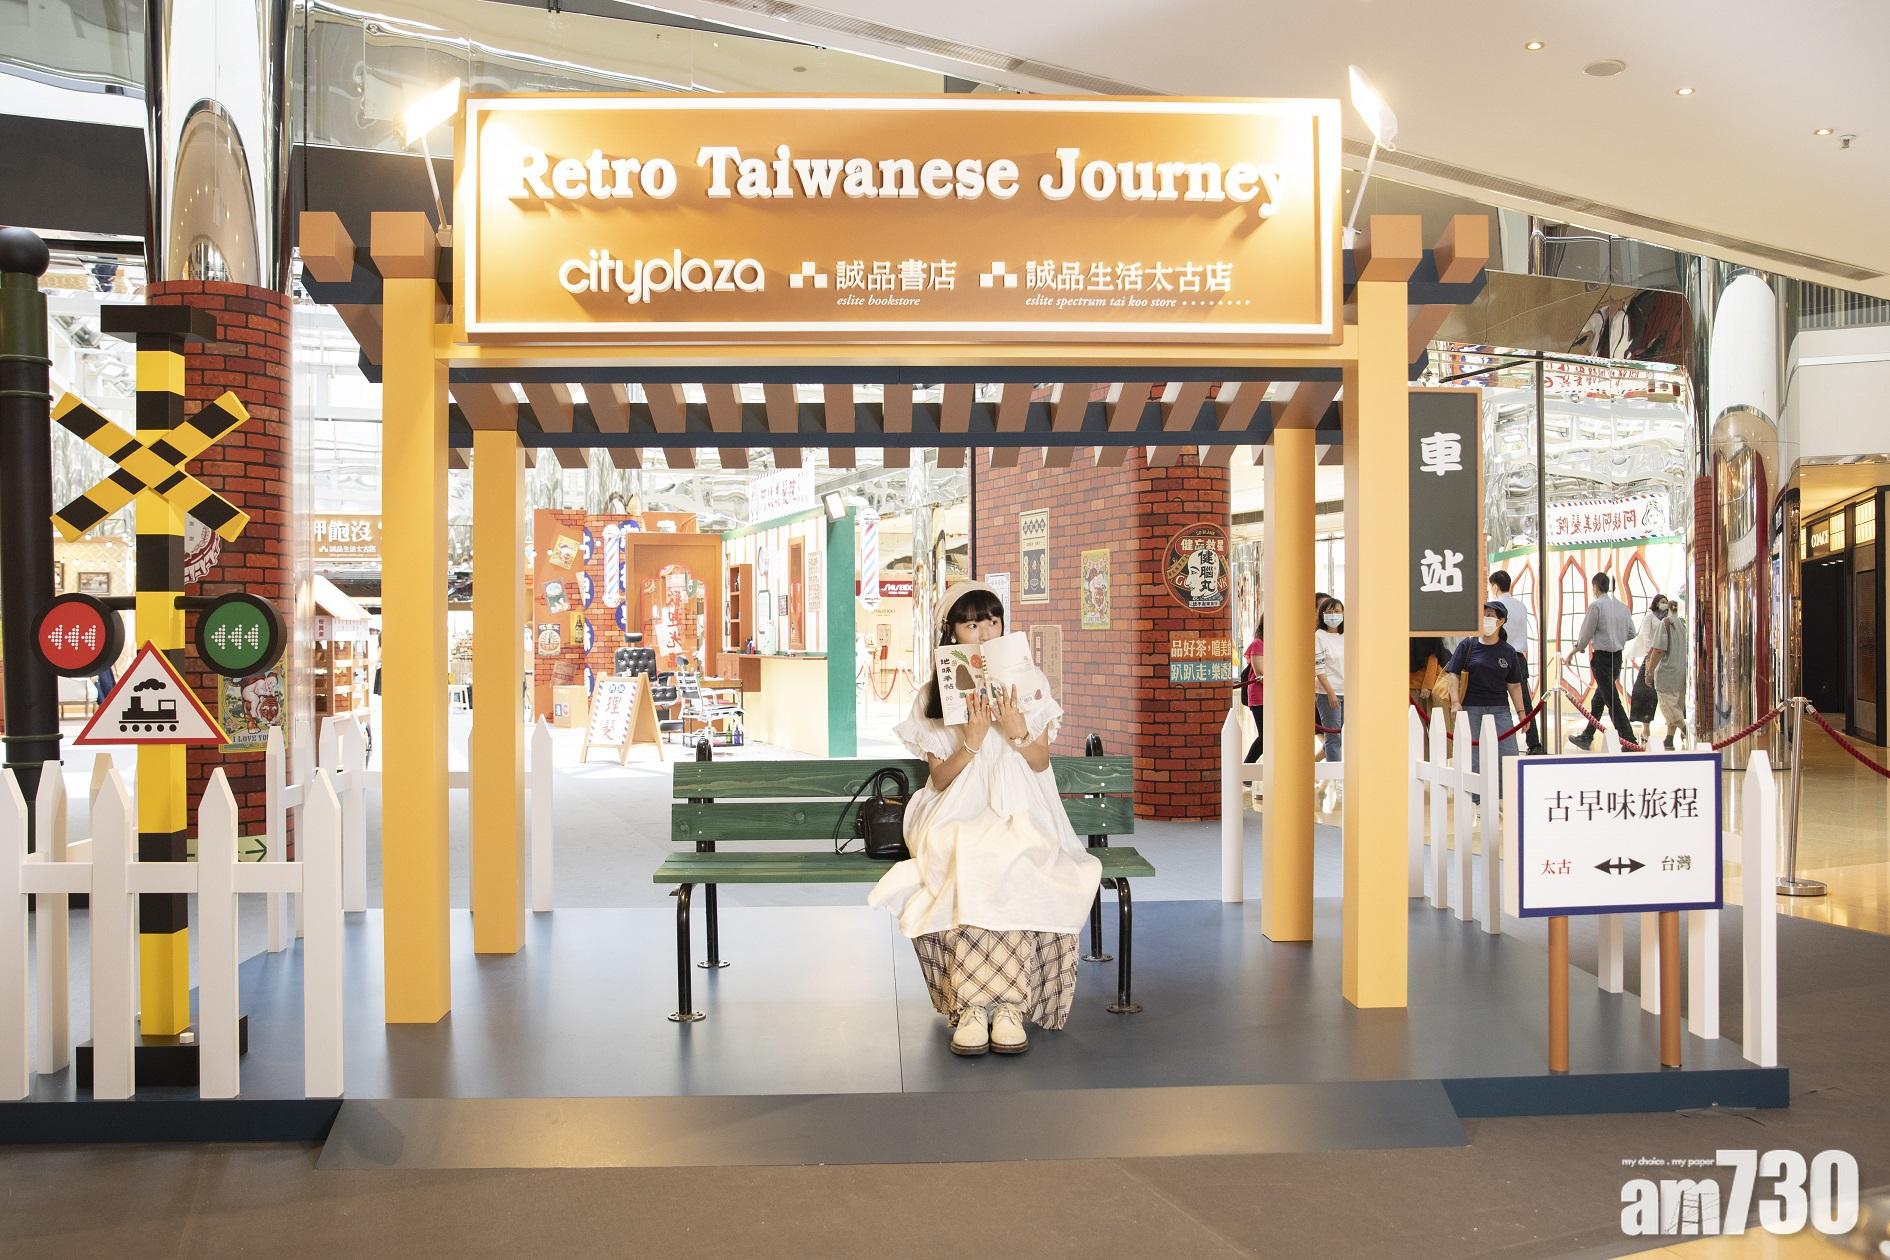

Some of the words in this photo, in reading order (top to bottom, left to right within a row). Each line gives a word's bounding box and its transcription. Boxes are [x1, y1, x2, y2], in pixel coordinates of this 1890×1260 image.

[506, 147, 677, 200] Retro
[696, 145, 1020, 201] Taiwanese
[1039, 147, 1287, 219] Journey
[558, 249, 765, 304] cityplaza
[836, 259, 957, 291] 誠品書店
[1025, 260, 1233, 292] 誠品生活太古店
[837, 294, 864, 306] eslite
[868, 294, 921, 306] bookstore
[1025, 294, 1054, 306] eslite
[1056, 296, 1106, 310] spectrum
[1109, 294, 1125, 307] tai
[1128, 294, 1148, 307] koo
[1150, 296, 1177, 307] store
[1419, 431, 1464, 593] 車站
[238, 734, 257, 743] LOVE
[1543, 787, 1700, 823] 古早味旅程
[1541, 858, 1572, 876] 太古
[1661, 854, 1692, 872] 台灣
